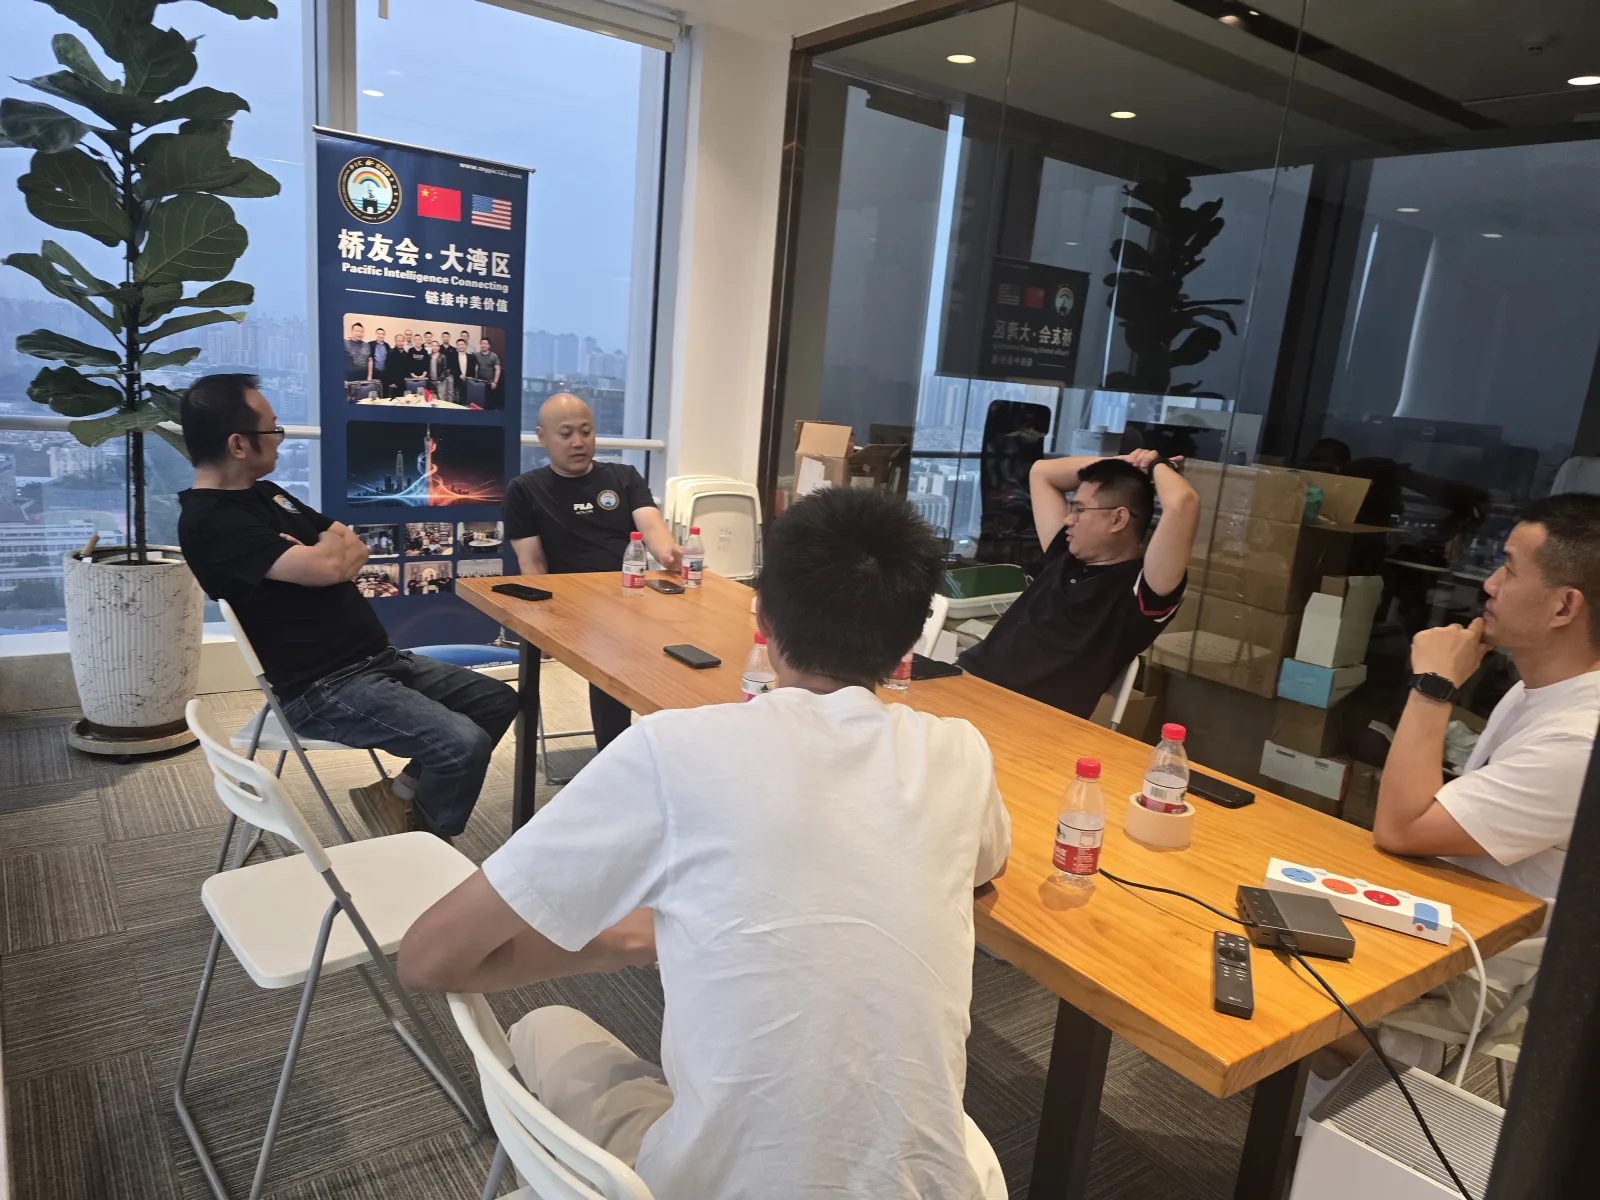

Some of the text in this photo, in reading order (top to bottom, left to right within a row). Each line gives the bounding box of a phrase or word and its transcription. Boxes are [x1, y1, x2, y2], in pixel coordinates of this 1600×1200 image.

[338, 229, 511, 278] 桥友会·大湾区
[342, 262, 509, 293] Pacific Intelligence Connecting
[424, 290, 508, 312] 链接中美价值
[573, 502, 594, 511] FILA
